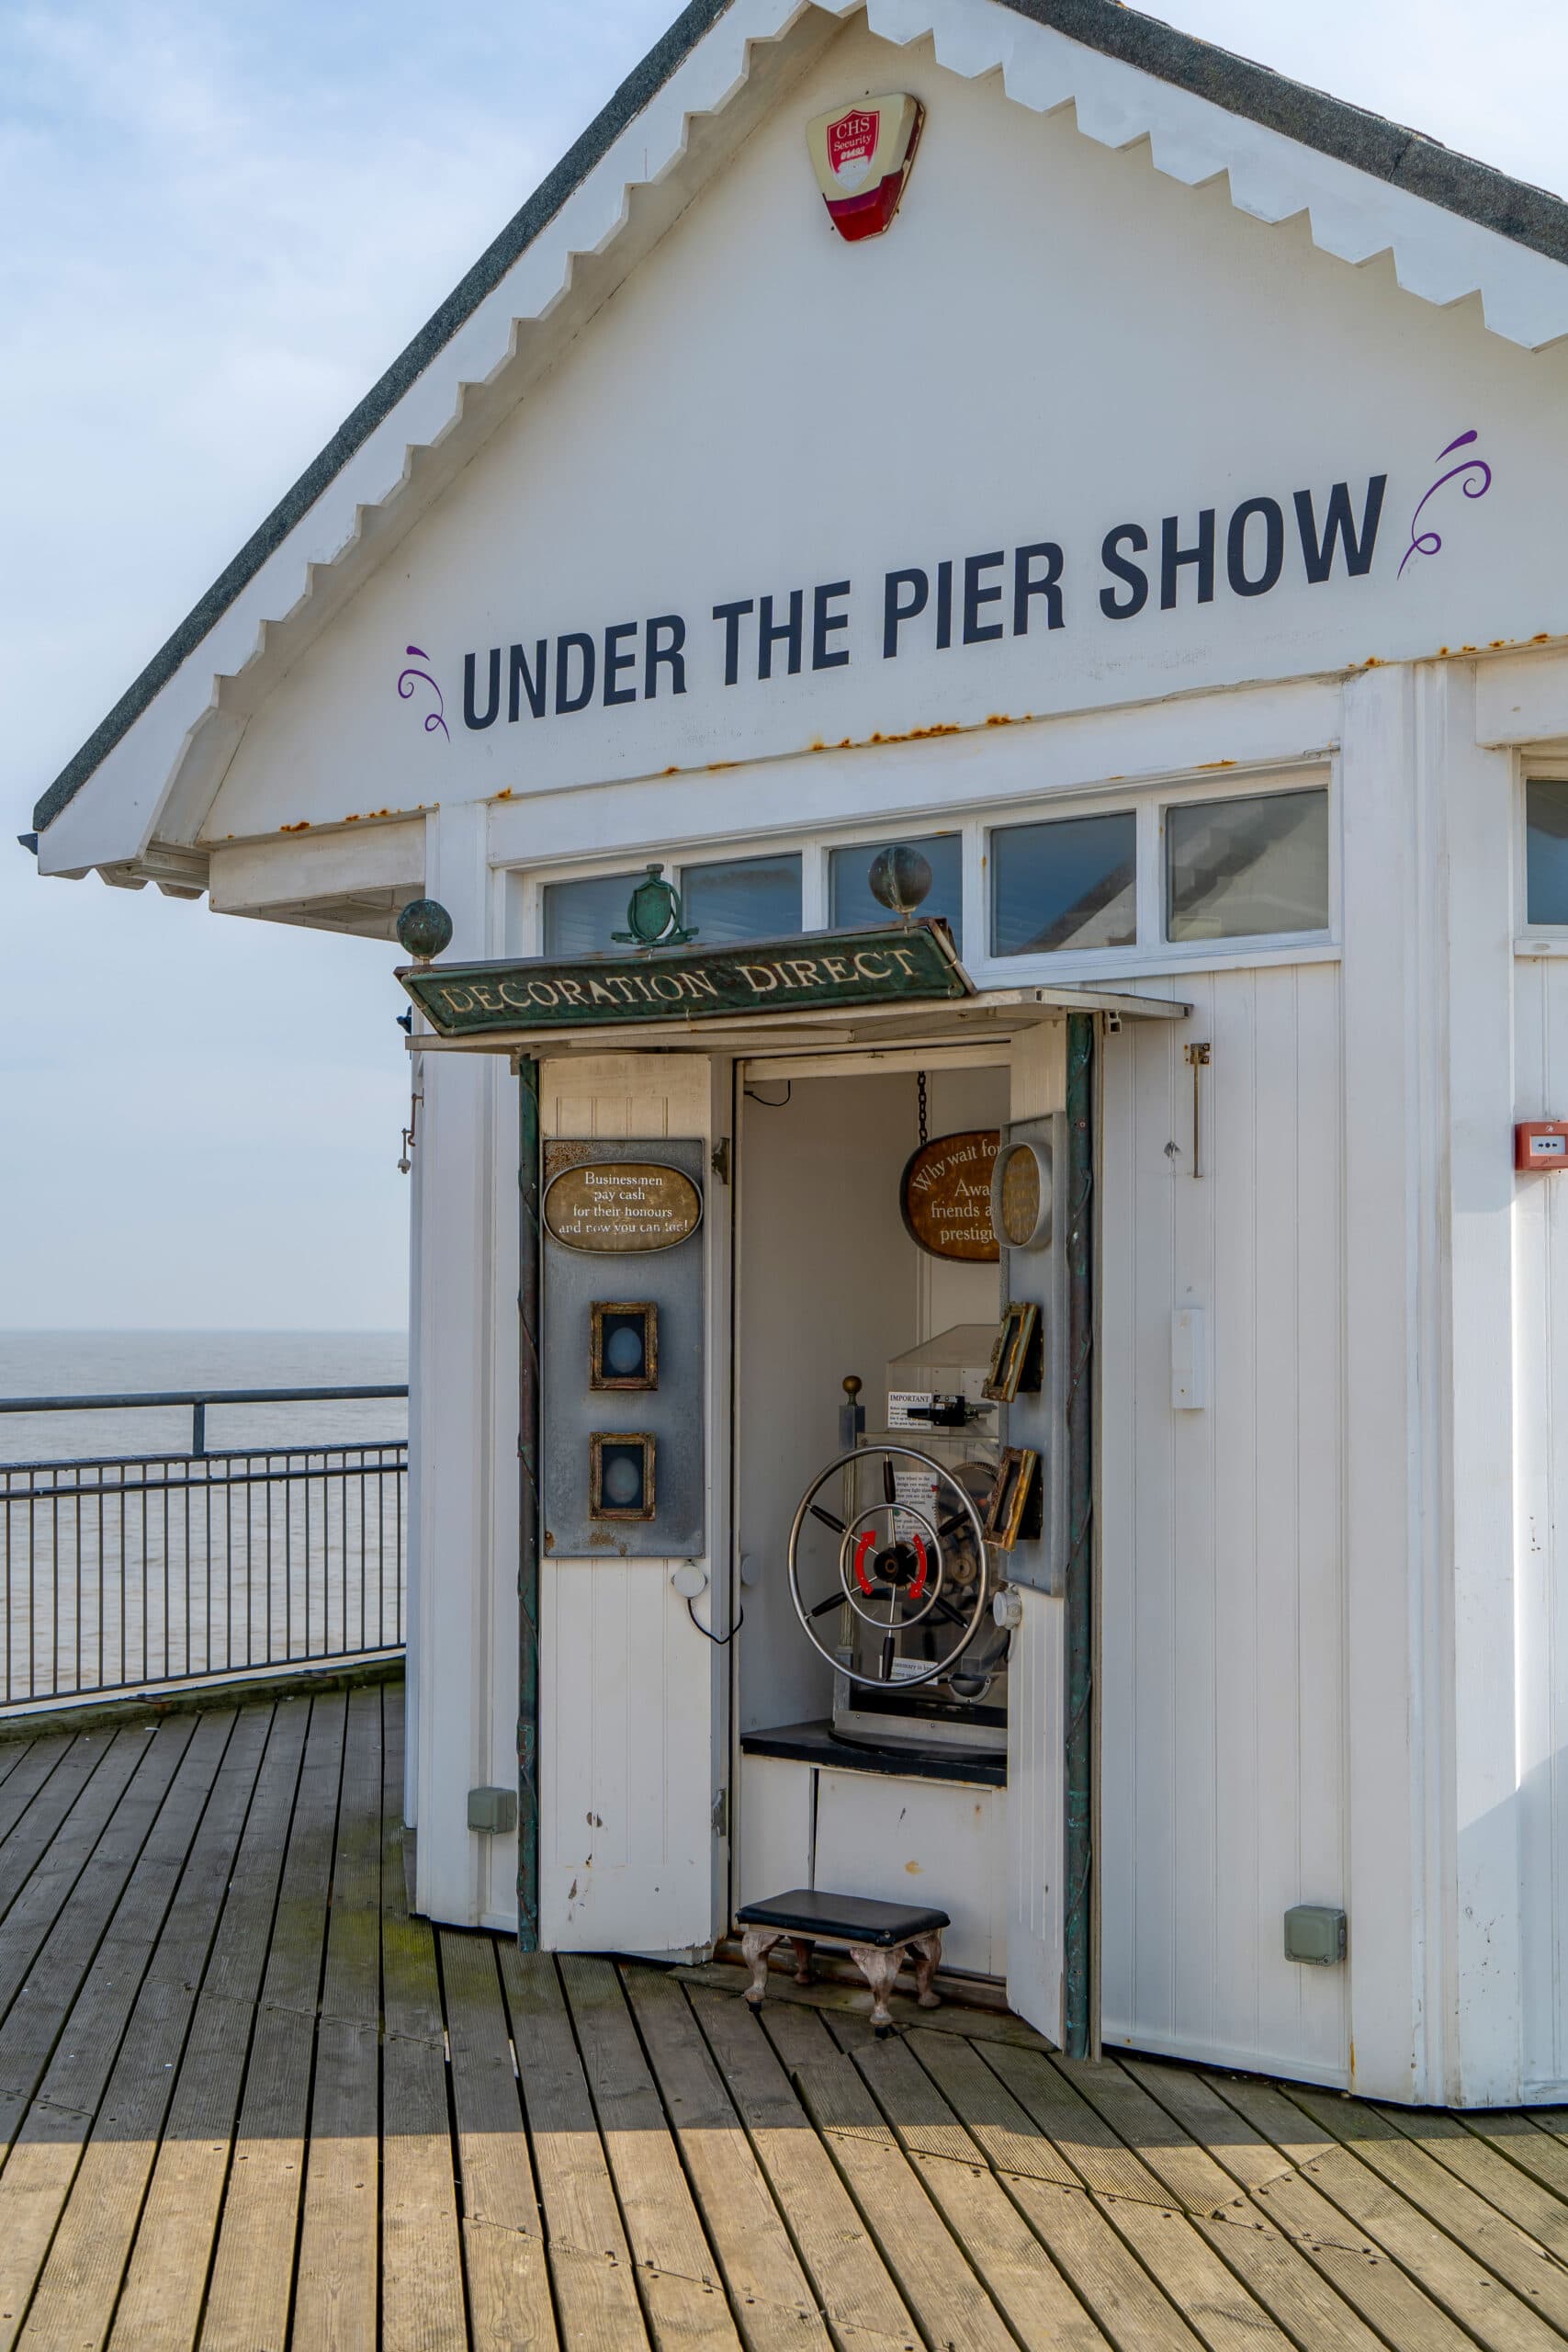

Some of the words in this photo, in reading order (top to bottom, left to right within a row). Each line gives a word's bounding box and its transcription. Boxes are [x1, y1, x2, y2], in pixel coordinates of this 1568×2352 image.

[836, 117, 870, 140] CHS
[833, 133, 872, 152] Security
[463, 614, 688, 731] UNDER
[712, 580, 852, 687] THE
[882, 542, 1066, 660] PIER
[1099, 473, 1389, 620] SHOW
[439, 969, 719, 1013] DECORATION
[736, 948, 920, 993] DIRECT
[585, 1170, 663, 1186] Businessmen
[911, 1160, 945, 1192] Why
[946, 1146, 978, 1167] wait
[593, 1191, 615, 1203] pay
[618, 1187, 646, 1201] cash
[573, 1204, 591, 1217] for
[593, 1205, 622, 1217] their
[625, 1204, 673, 1217] honours
[931, 1199, 980, 1218] friends
[558, 1220, 581, 1234] and
[586, 1224, 611, 1234] now
[614, 1224, 636, 1236] you
[639, 1224, 660, 1234] can
[889, 1394, 931, 1403] IMPORTANT
